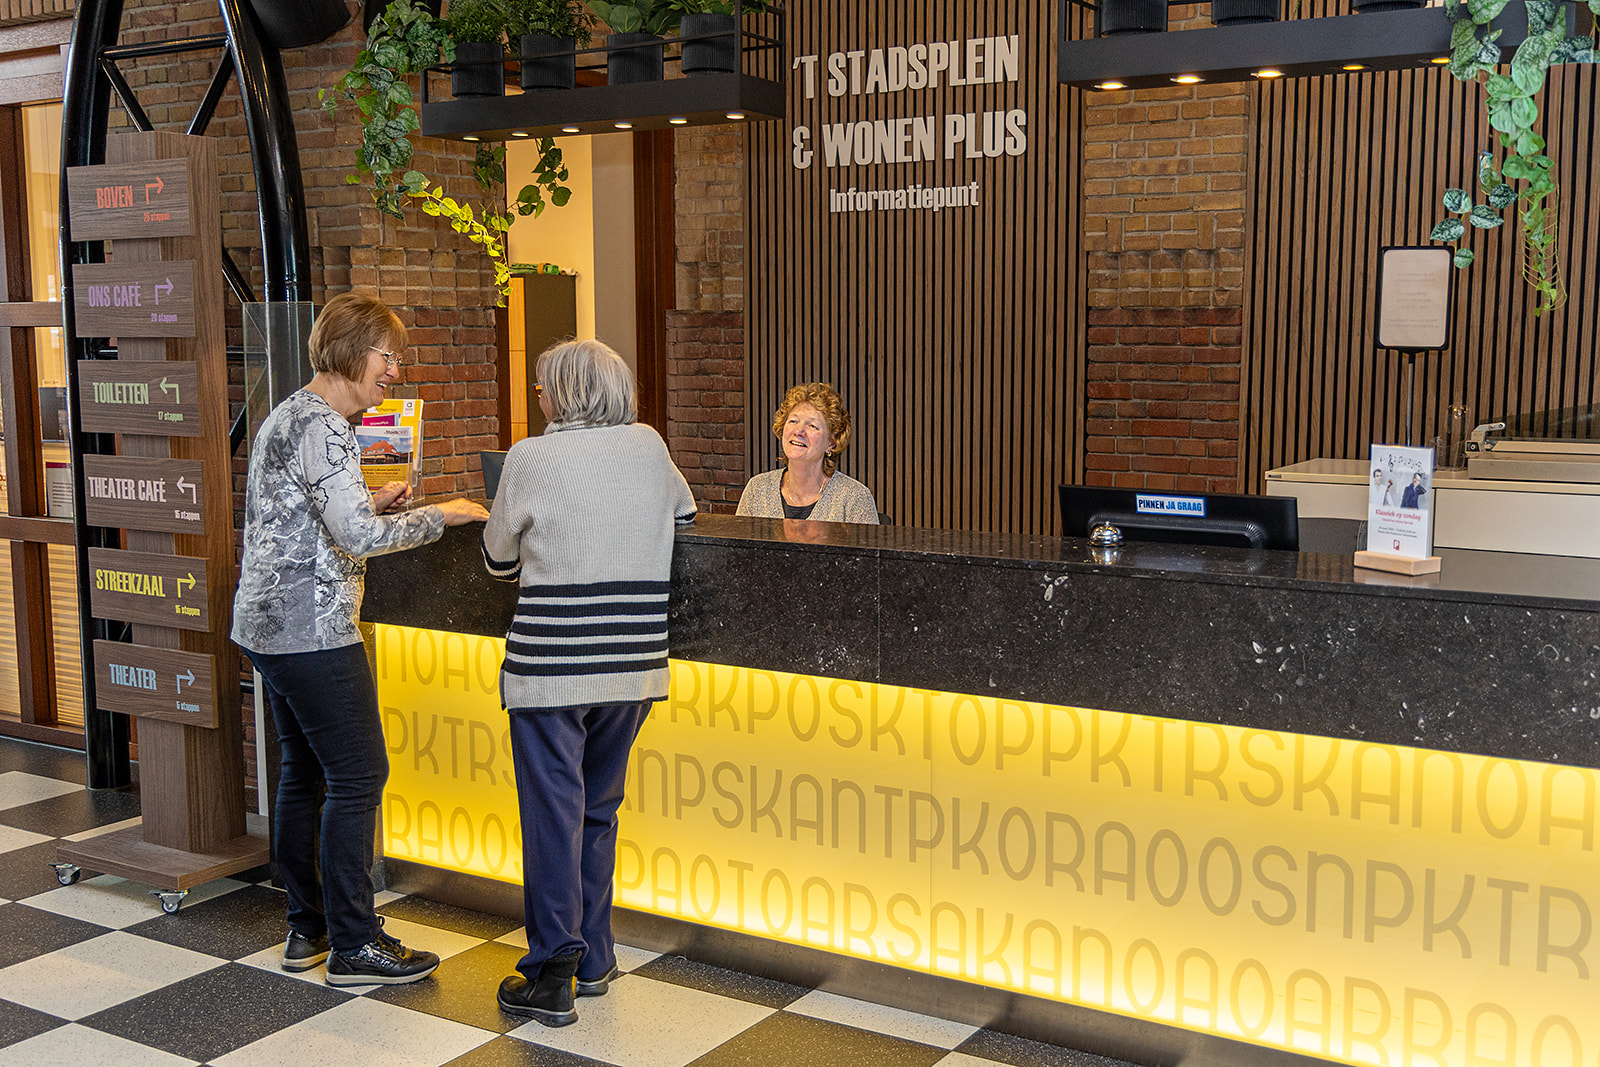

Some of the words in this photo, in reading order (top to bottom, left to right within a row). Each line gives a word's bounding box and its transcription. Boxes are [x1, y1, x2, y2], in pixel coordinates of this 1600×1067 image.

[827, 34, 1019, 97] STADSPLEIN
[792, 125, 813, 169] &
[822, 115, 935, 168] WONEN
[944, 109, 1027, 160] PLUS
[96, 185, 134, 209] BOVEN
[829, 181, 980, 213] Informatiepunt
[88, 285, 112, 307] ONS
[113, 281, 142, 307] CAFÉ
[92, 382, 149, 405] TOILETTEN
[88, 476, 136, 501] THEATER
[137, 478, 166, 502] CAFÉ
[1138, 499, 1165, 510] PINNEN
[1166, 501, 1176, 511] JA
[1177, 502, 1203, 512] GRAAG
[95, 569, 166, 598] STREEKZAAL
[109, 663, 157, 690] THEATER
